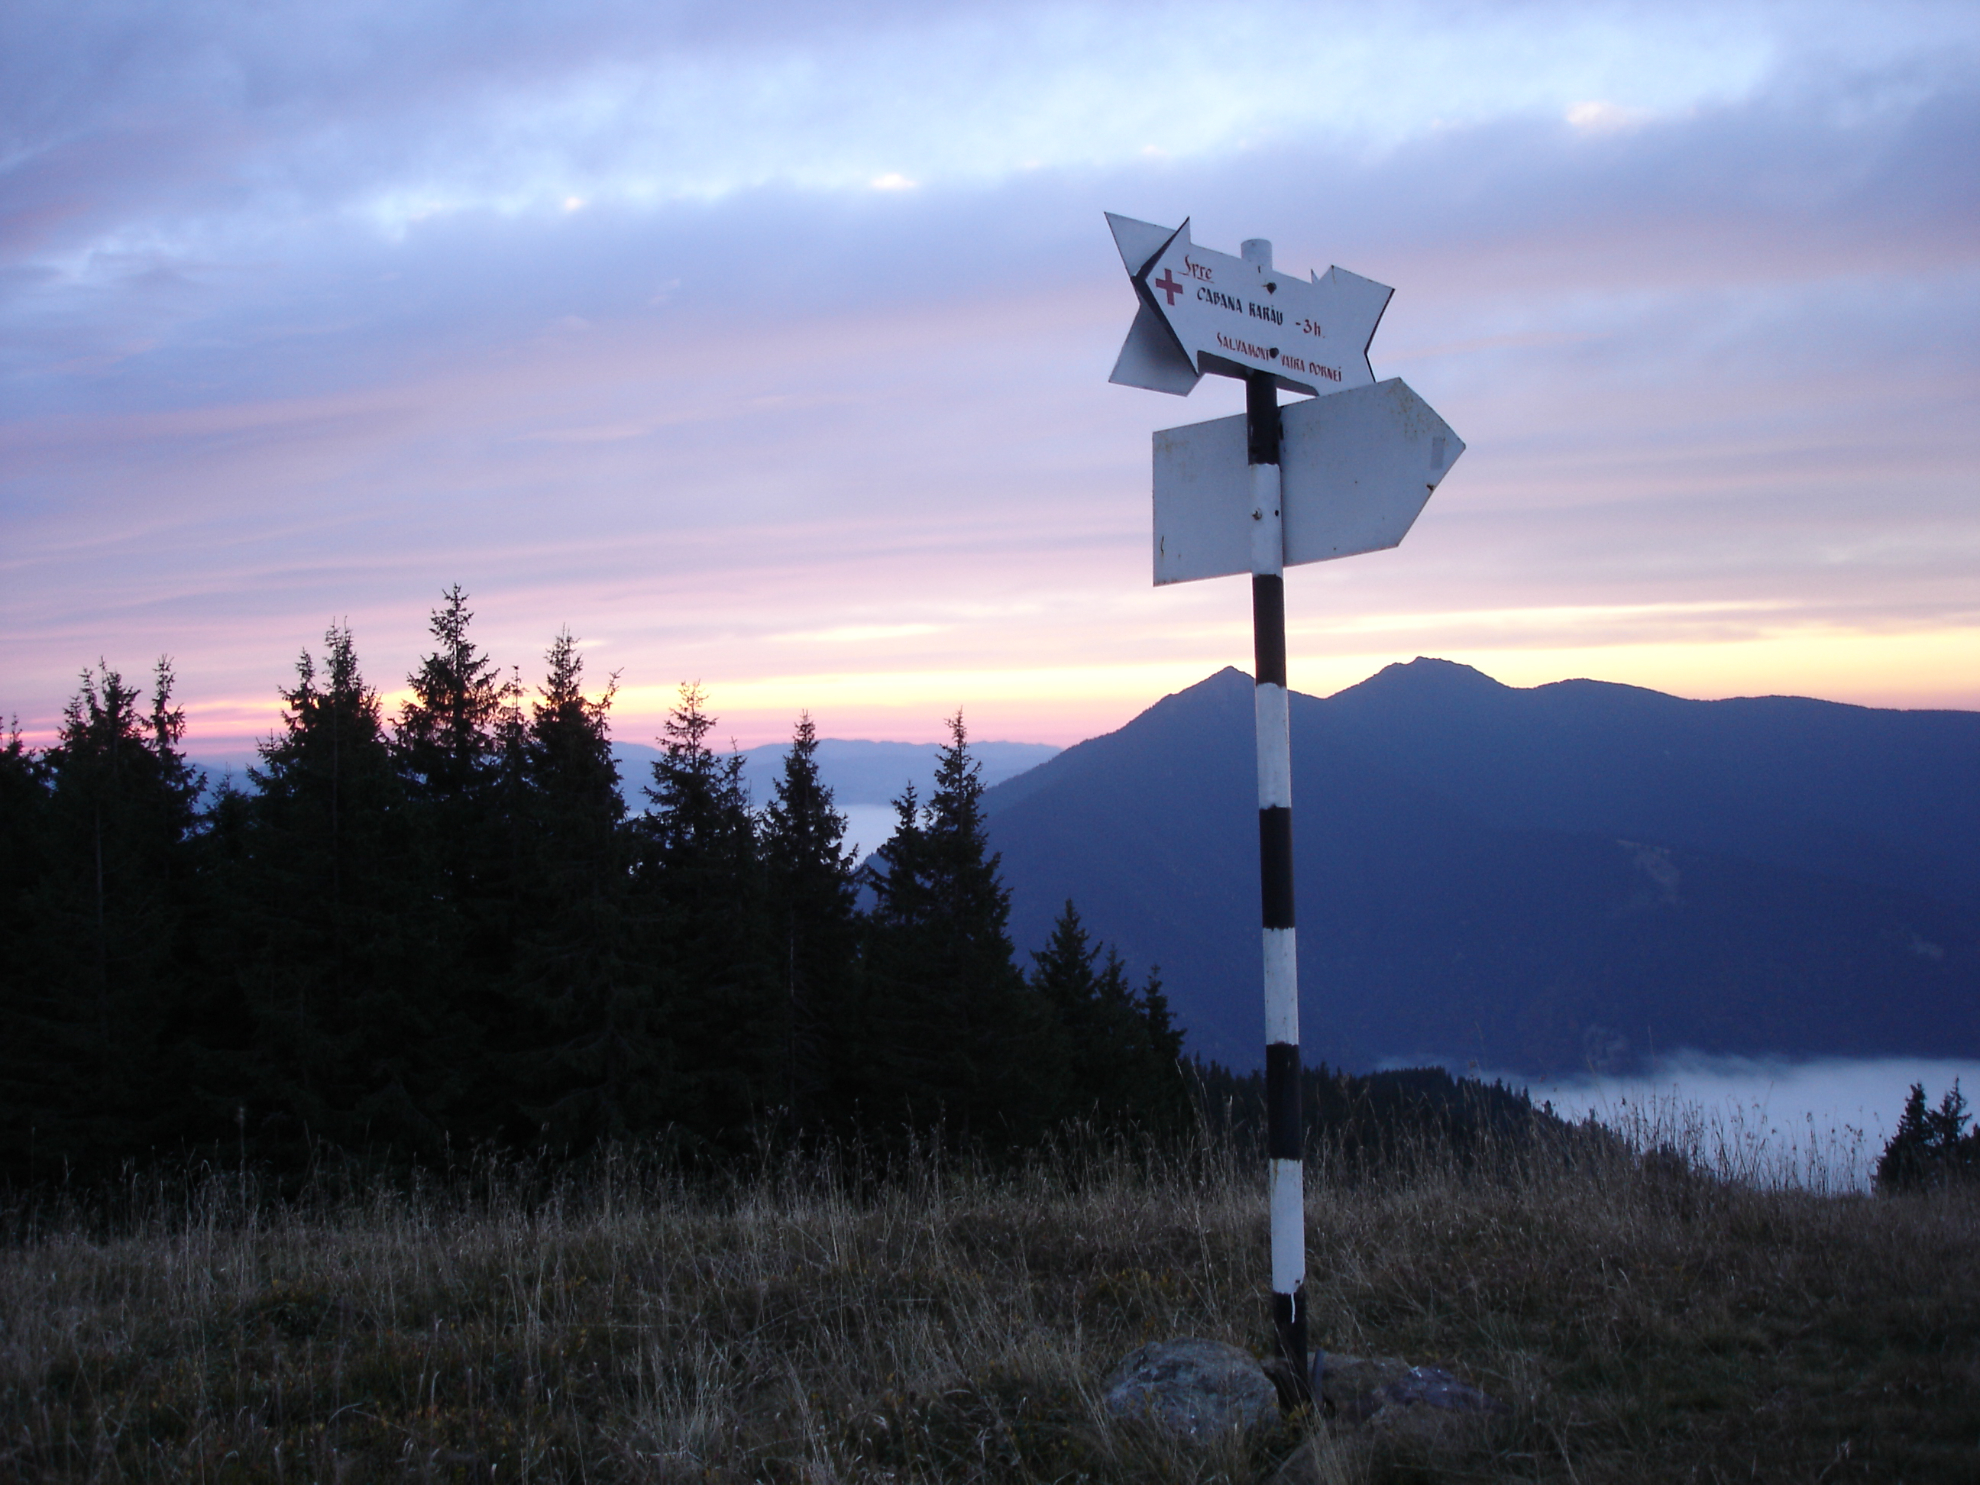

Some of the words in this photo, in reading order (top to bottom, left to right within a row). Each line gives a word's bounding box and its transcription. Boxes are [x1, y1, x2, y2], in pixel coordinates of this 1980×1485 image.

[1178, 254, 1214, 283] Spre
[1197, 287, 1242, 313] CABANA
[1280, 354, 1305, 372] VATRA
